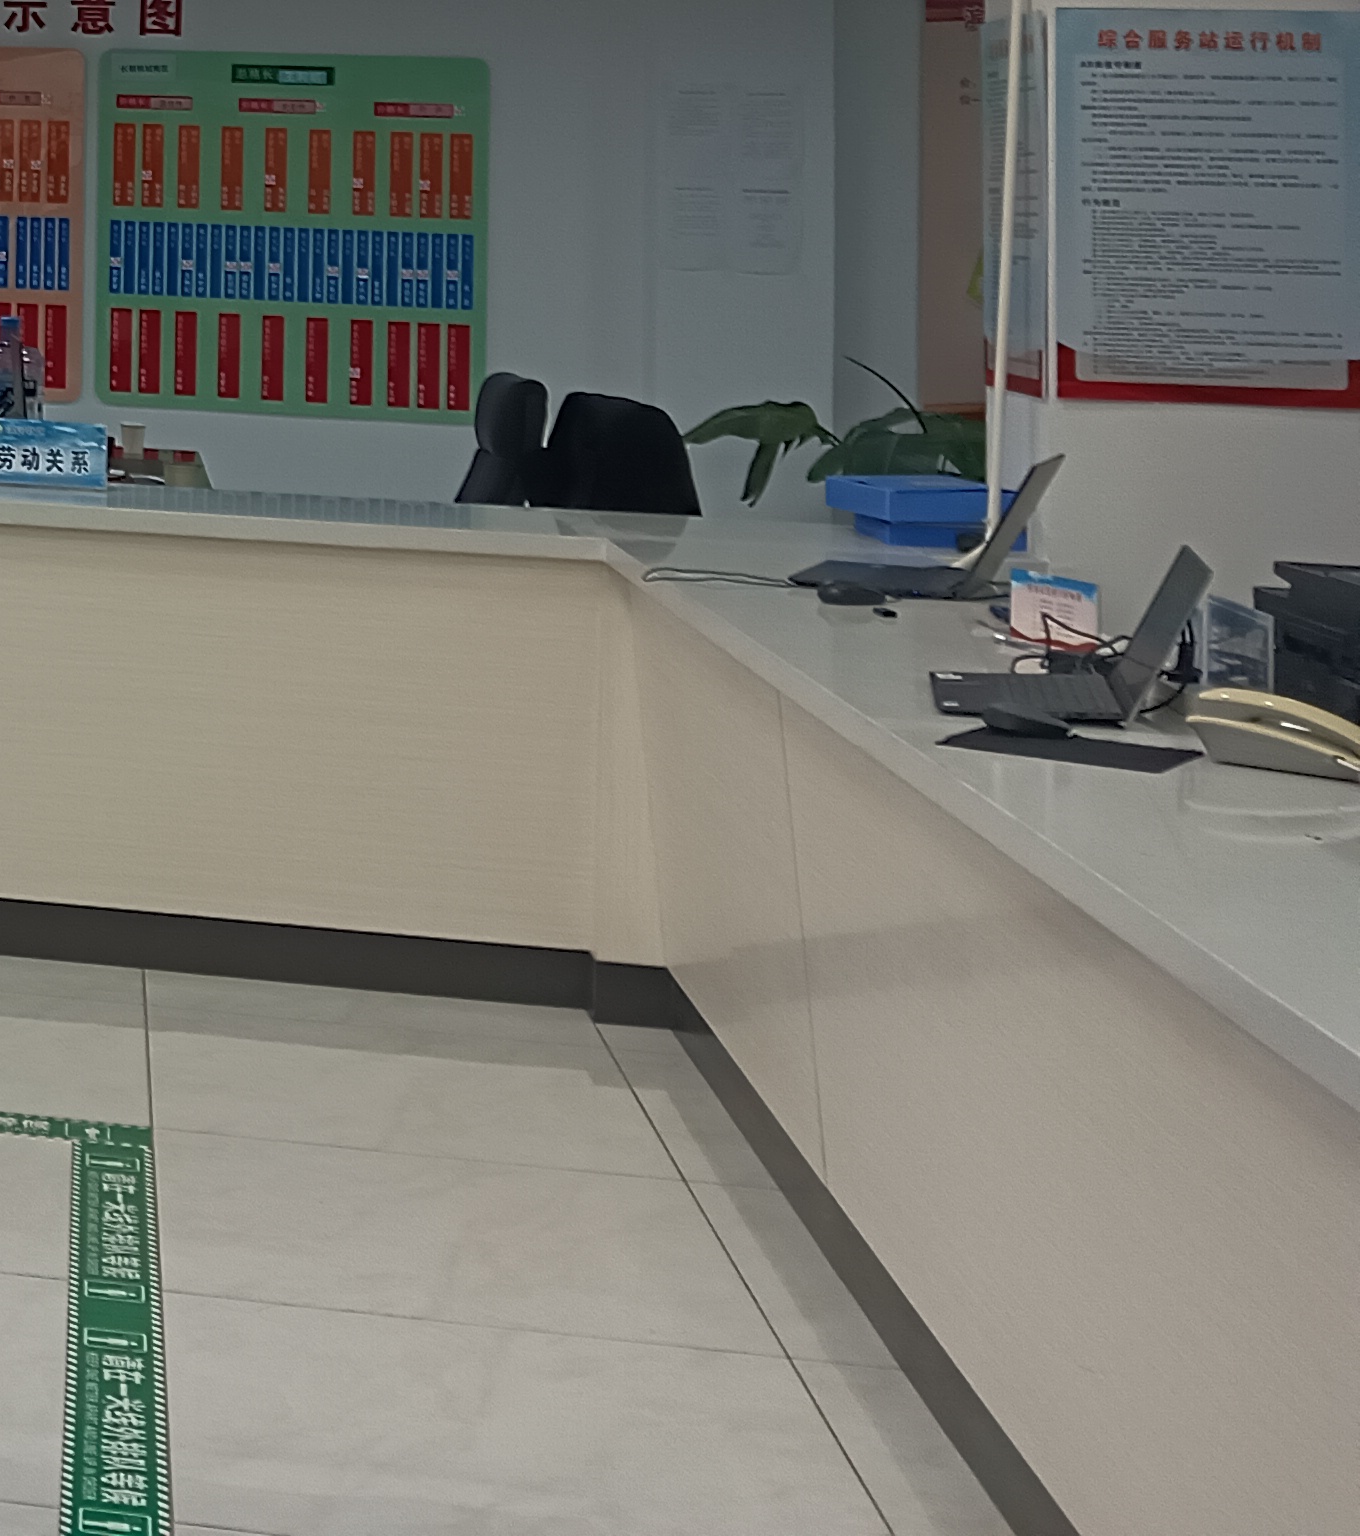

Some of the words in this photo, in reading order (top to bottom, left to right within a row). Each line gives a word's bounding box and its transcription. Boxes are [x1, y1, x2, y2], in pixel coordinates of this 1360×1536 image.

[1097, 29, 1323, 53] 综合服务站运行机制
